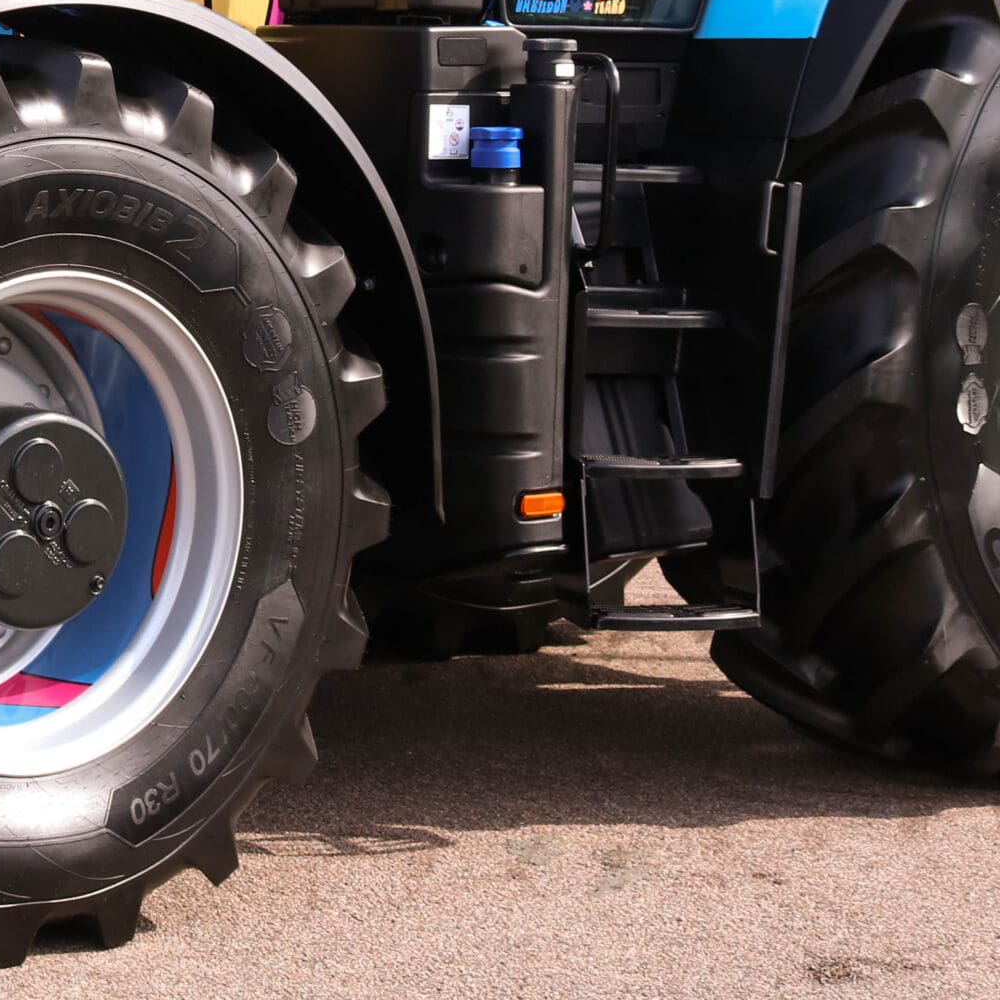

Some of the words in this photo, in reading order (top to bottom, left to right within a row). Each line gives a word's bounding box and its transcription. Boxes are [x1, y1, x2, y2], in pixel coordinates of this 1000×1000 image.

[24, 188, 174, 233] AXIOBIB
[165, 214, 211, 262] 2
[129, 771, 183, 826] R30
